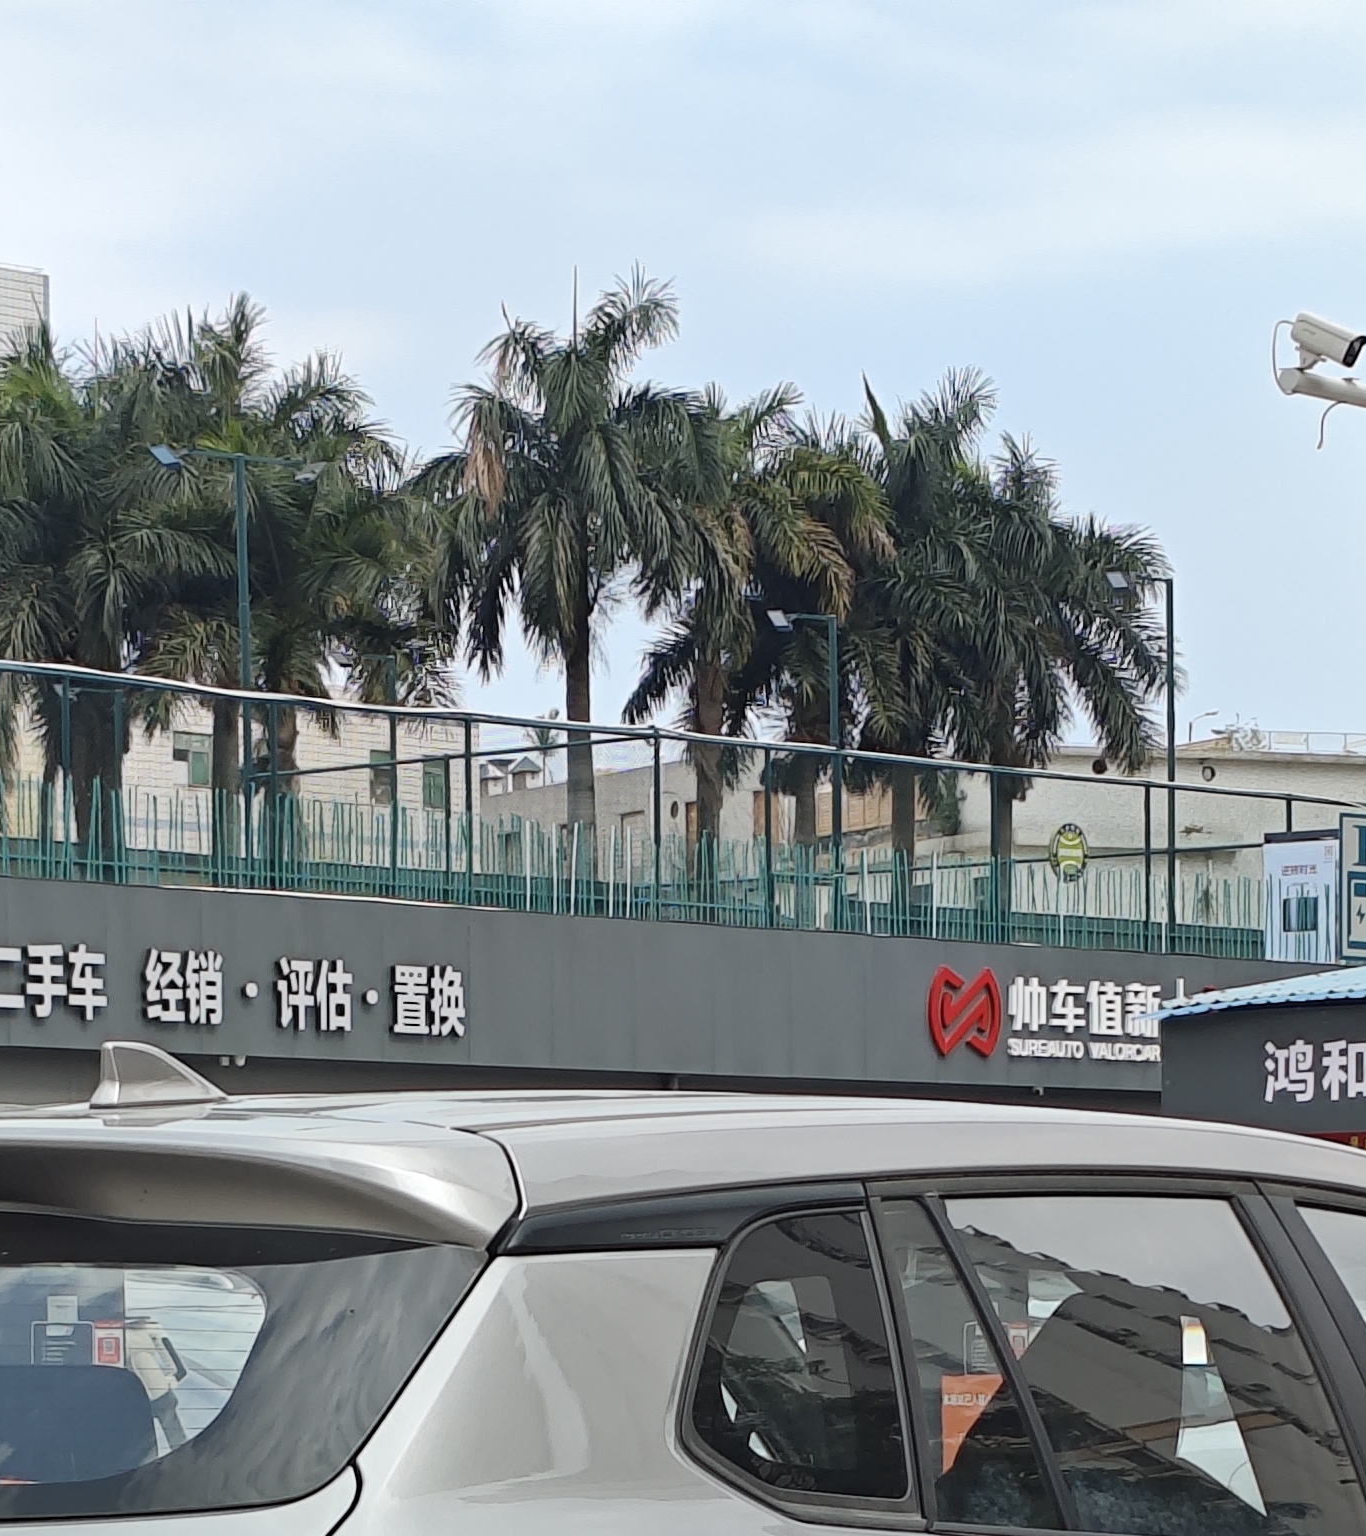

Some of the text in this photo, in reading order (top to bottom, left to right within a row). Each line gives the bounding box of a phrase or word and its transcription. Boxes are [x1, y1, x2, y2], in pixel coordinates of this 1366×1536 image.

[1008, 976, 1189, 1038] 帅车值新
[1007, 1037, 1084, 1058] SUREAUTO
